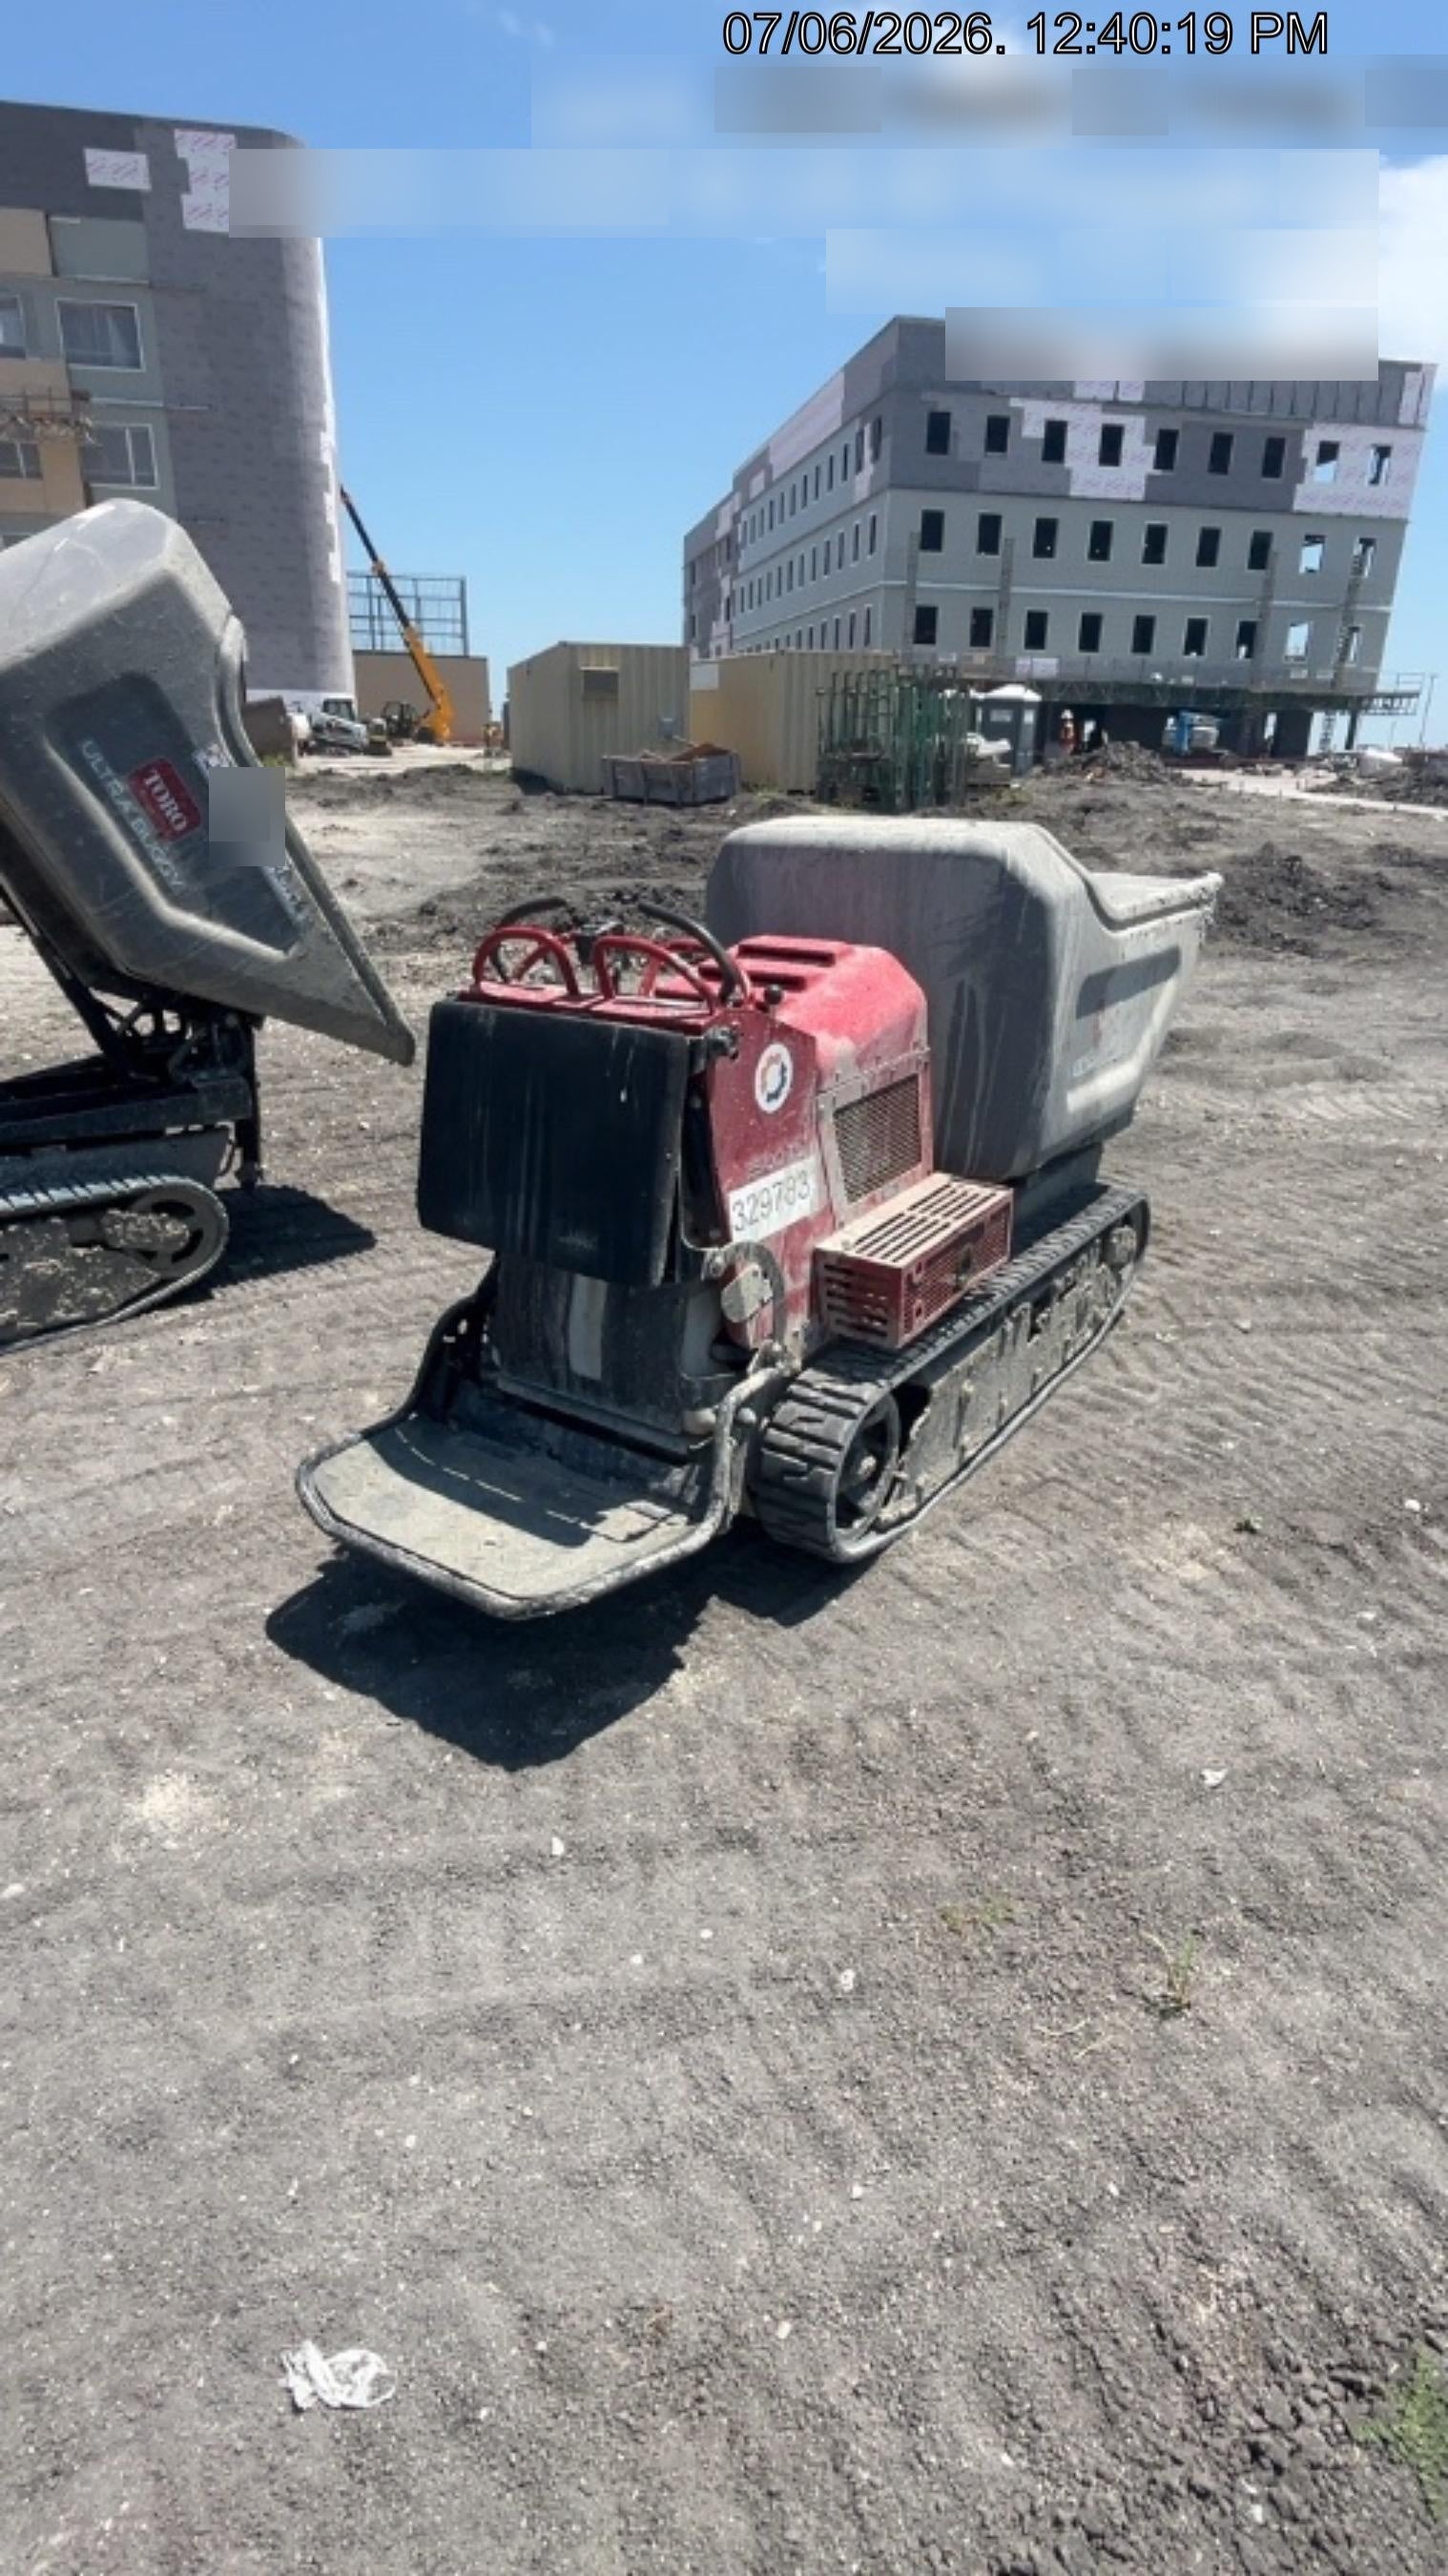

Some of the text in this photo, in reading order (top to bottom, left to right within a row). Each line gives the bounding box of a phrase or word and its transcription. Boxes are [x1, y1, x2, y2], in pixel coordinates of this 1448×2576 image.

[82, 739, 184, 887] ULTRA BUGGY
[144, 767, 188, 832] TORO
[732, 1170, 811, 1232] 329783
